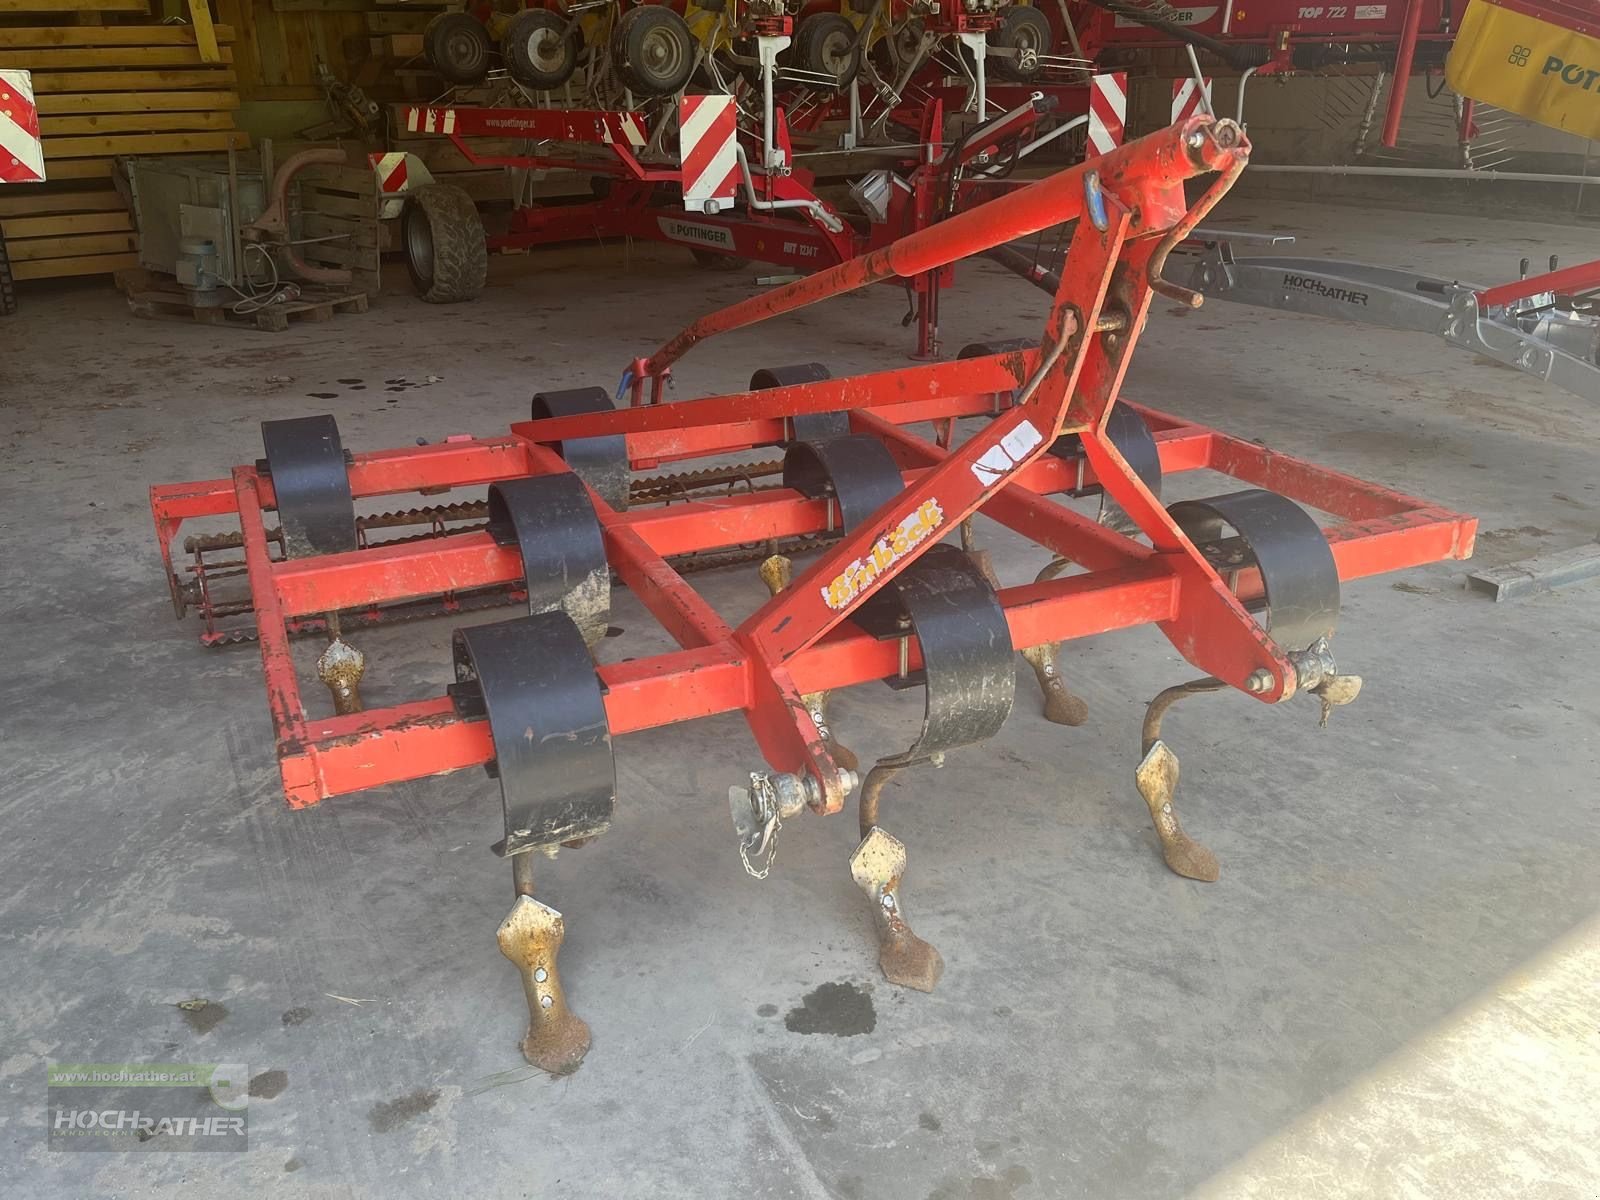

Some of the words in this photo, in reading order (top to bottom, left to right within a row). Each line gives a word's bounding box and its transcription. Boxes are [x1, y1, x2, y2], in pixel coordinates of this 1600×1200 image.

[1298, 7, 1324, 18] TOP
[1326, 6, 1348, 18] 722
[1283, 274, 1369, 306] HOCHRATHER
